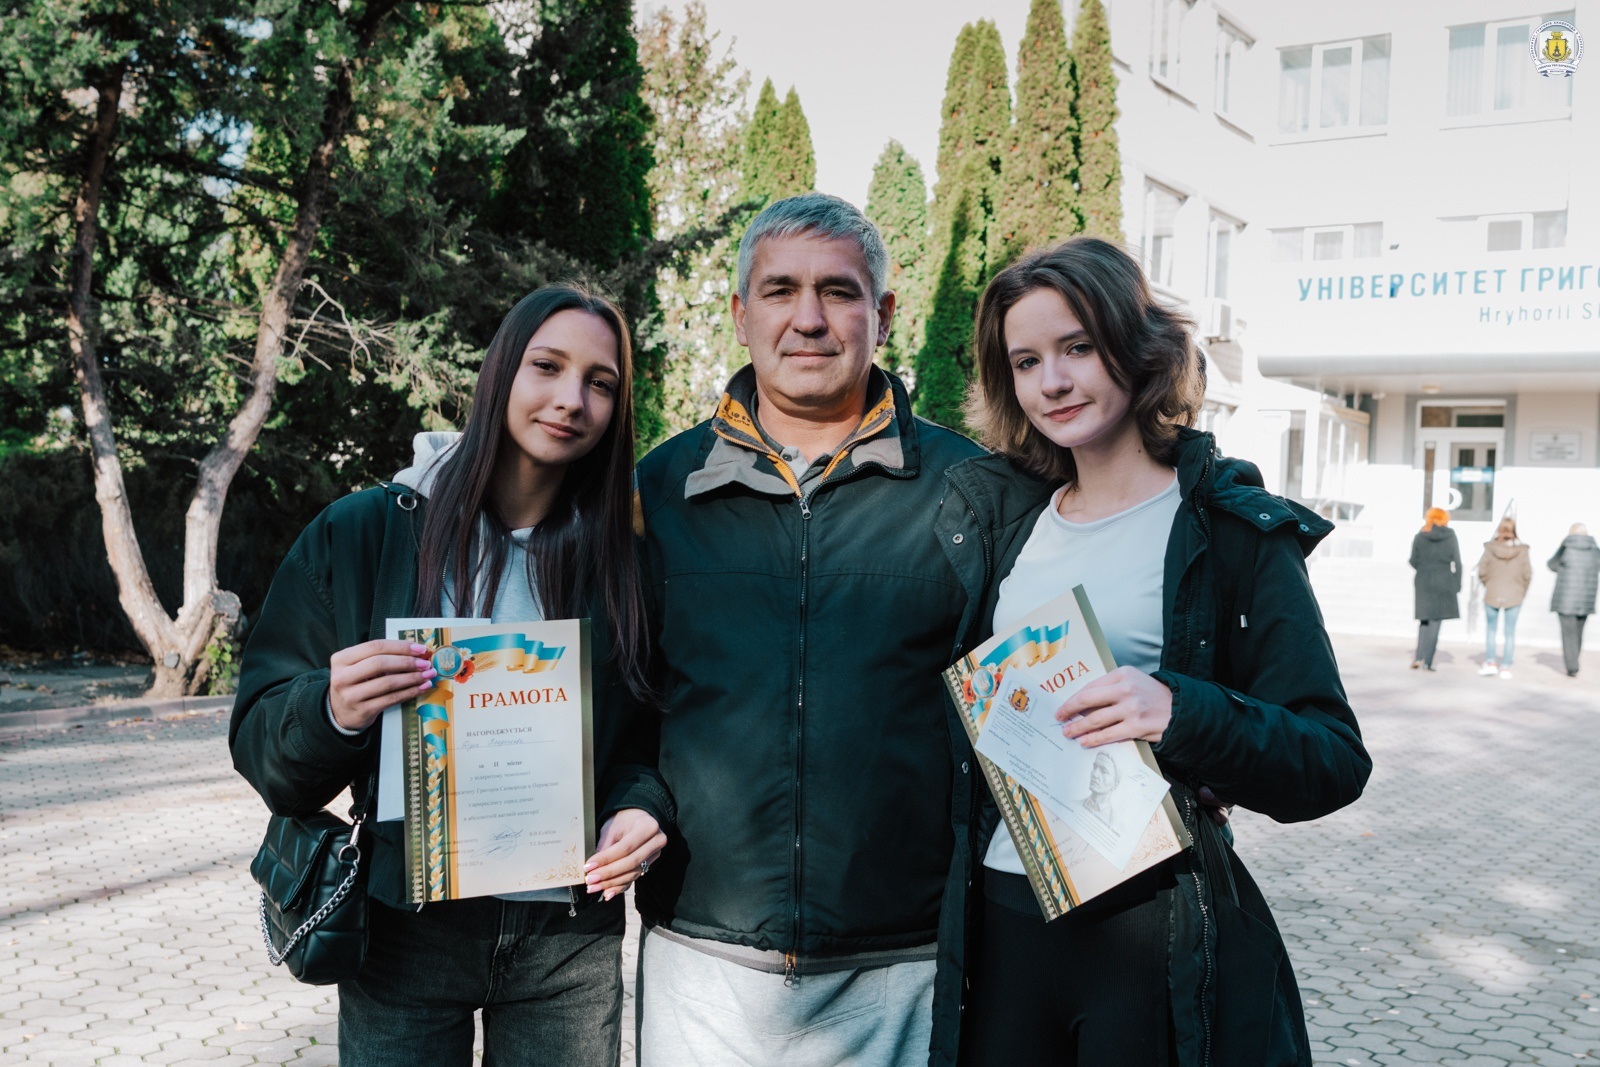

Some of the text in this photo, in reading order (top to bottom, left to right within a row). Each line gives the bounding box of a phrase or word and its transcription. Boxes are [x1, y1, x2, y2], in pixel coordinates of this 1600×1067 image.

[1298, 265, 1600, 301] УНІВЕРСИТЕТ ГРИГ
[1582, 302, 1600, 320] S
[469, 687, 568, 709] ГРАМОТА
[466, 726, 532, 738] НАГОРОДЖУЄТЬСЯ
